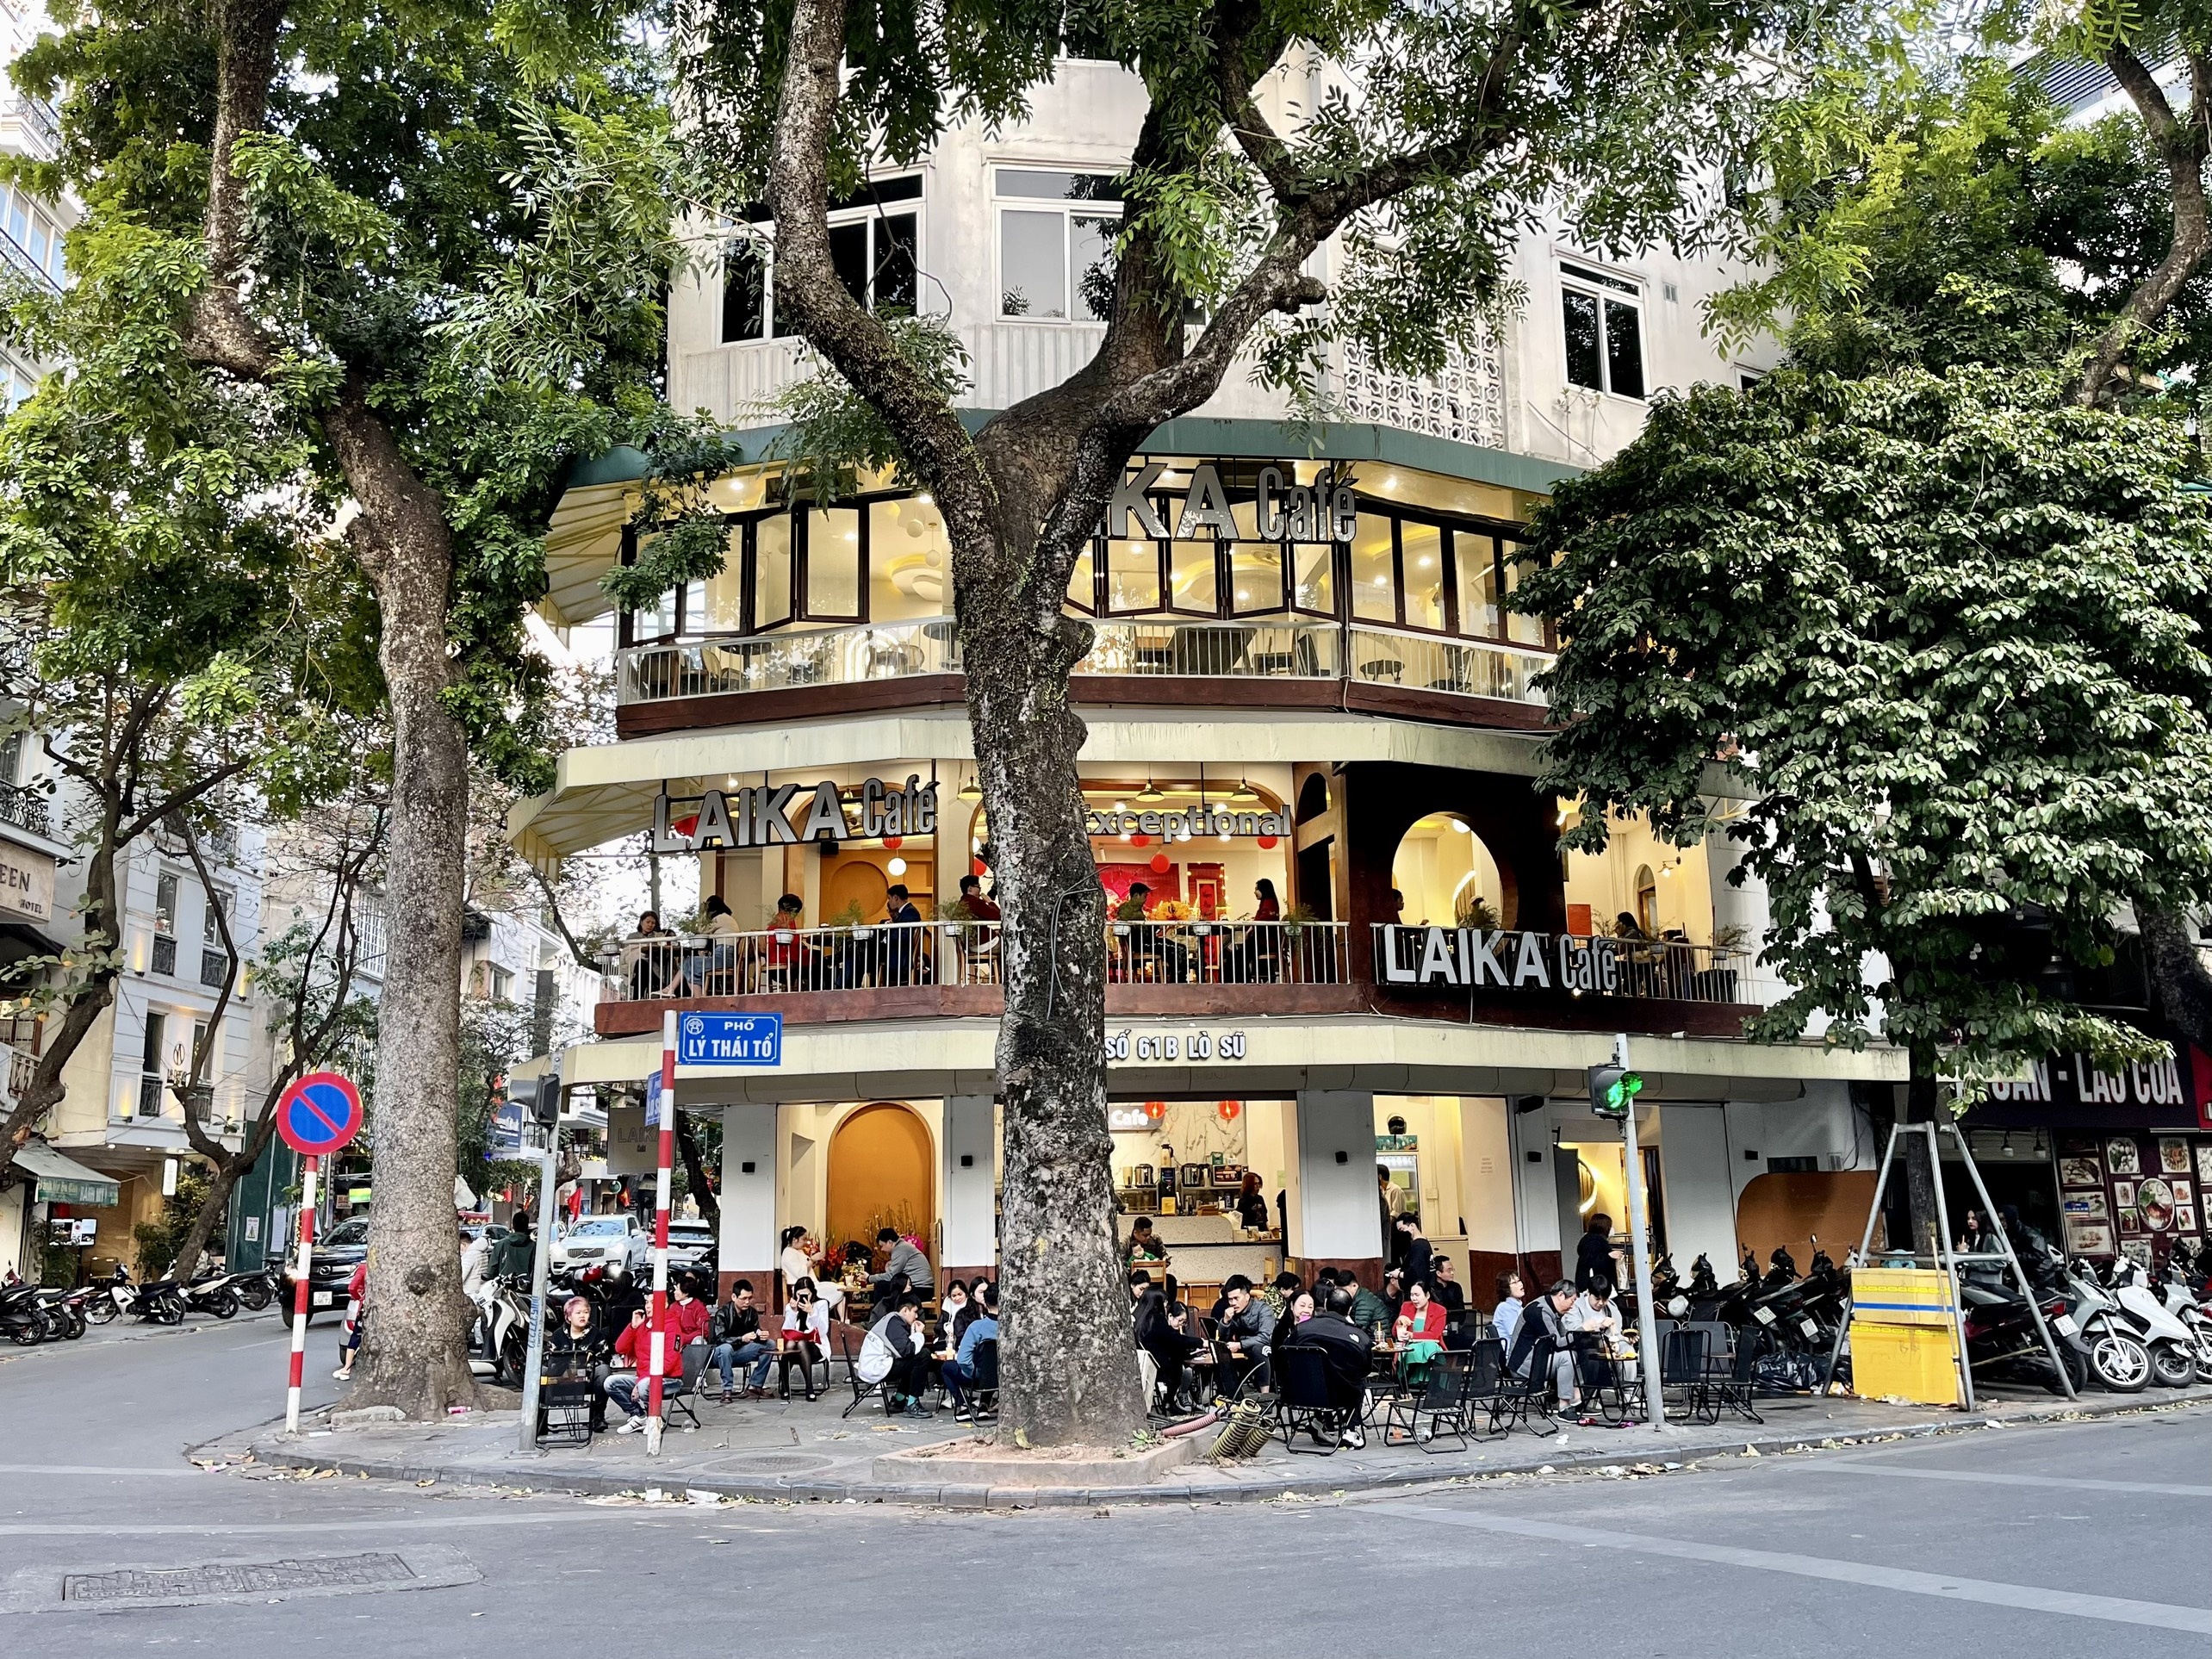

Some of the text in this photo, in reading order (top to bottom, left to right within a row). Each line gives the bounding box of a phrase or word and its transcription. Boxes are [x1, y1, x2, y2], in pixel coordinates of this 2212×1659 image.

[1108, 463, 1358, 542] KA Café
[654, 774, 940, 852] LAIKA Café
[20, 898, 42, 914] HOTEL
[1382, 923, 1550, 988] LAIKA
[724, 1018, 755, 1031] PHỐ
[689, 1032, 774, 1058] LÝ THÁI TỔ
[1105, 1029, 1131, 1059] SỐ
[1187, 1031, 1212, 1059] LÒ
[1219, 1031, 1246, 1059] SŨ
